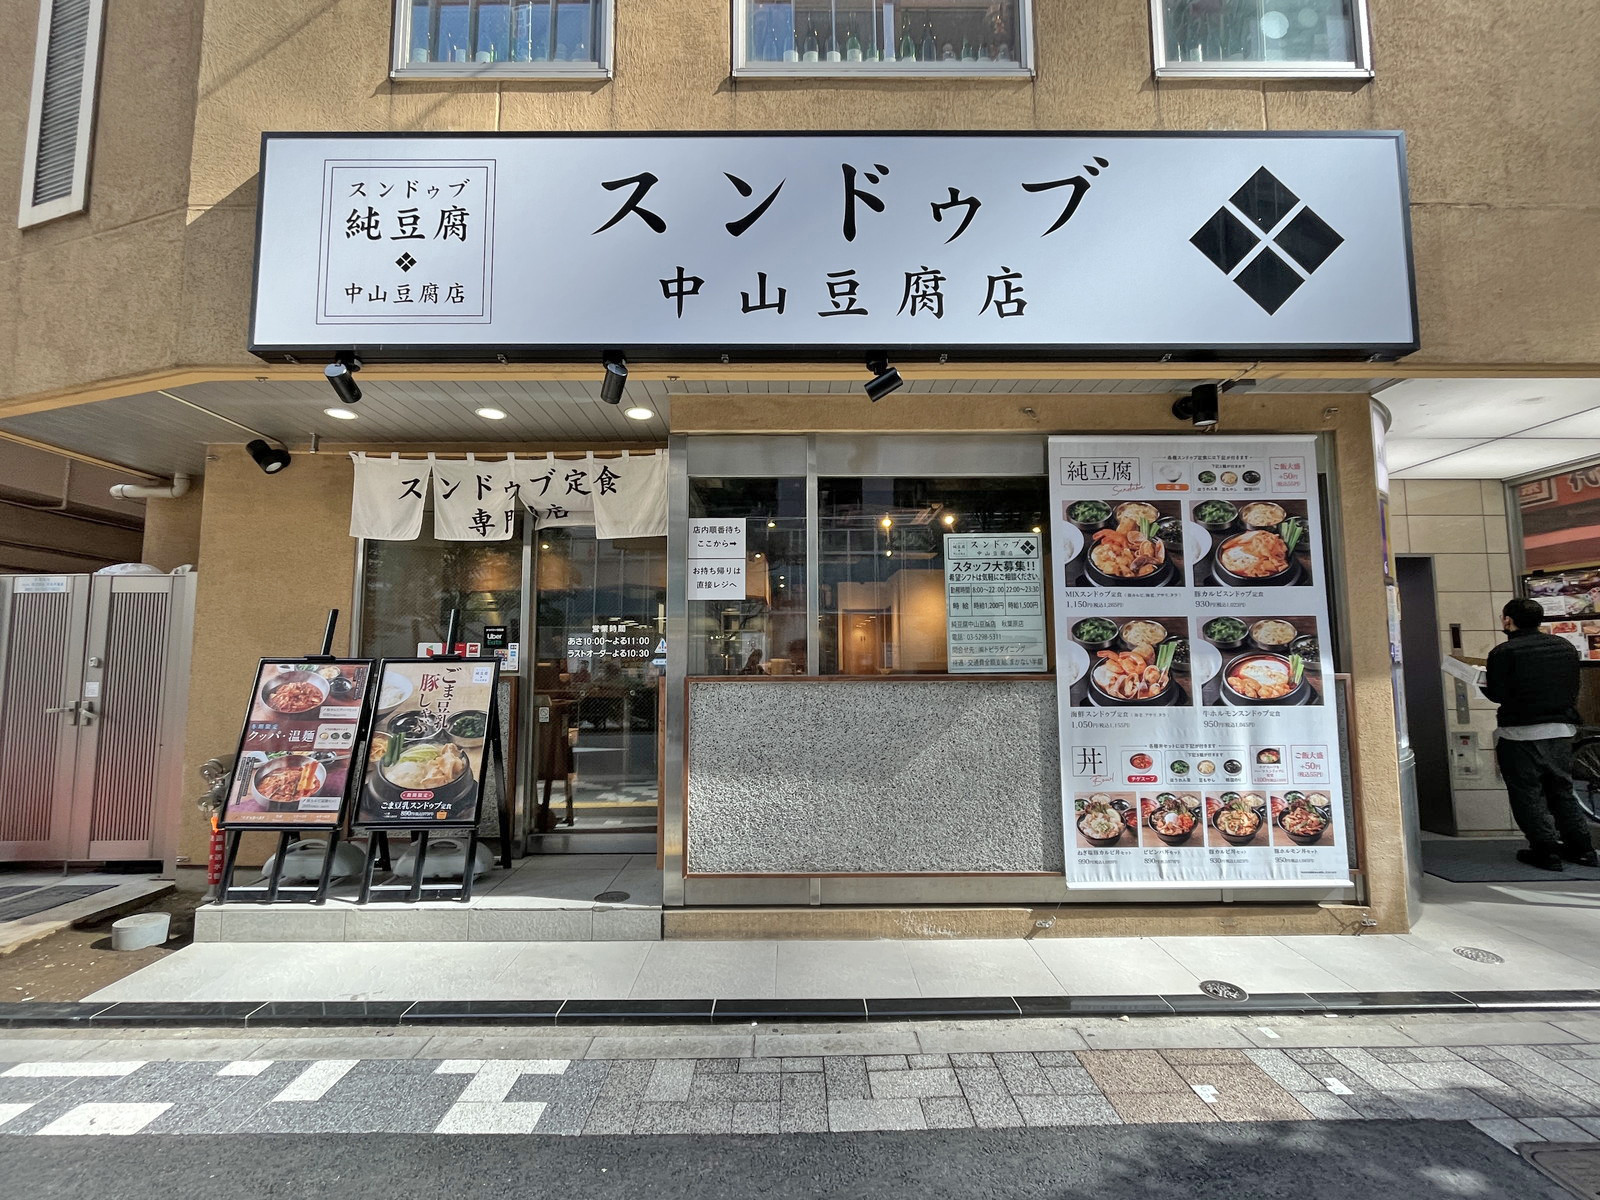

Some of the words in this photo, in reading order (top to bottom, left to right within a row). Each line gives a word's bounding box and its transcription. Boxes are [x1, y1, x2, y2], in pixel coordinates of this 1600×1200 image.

[348, 178, 471, 199] スンドゥブ
[591, 156, 1109, 245] スンドゥブ
[345, 204, 471, 242] 純豆腐
[344, 282, 466, 305] 中山豆腐店
[659, 265, 1028, 319] 中山豆腐店
[1067, 460, 1132, 481] 純豆腐
[398, 465, 621, 501] スンドゥブ定食
[692, 526, 741, 534] 店内順番待ち
[692, 567, 741, 575] お持ち帰りは
[696, 581, 737, 589] 直接レジへ
[592, 625, 626, 633] 営業時間
[412, 674, 440, 734] 豚しゃぶ
[434, 667, 462, 728] ごま豆乳
[247, 730, 316, 742] クッパ・温麺
[1077, 748, 1103, 774] 丼
